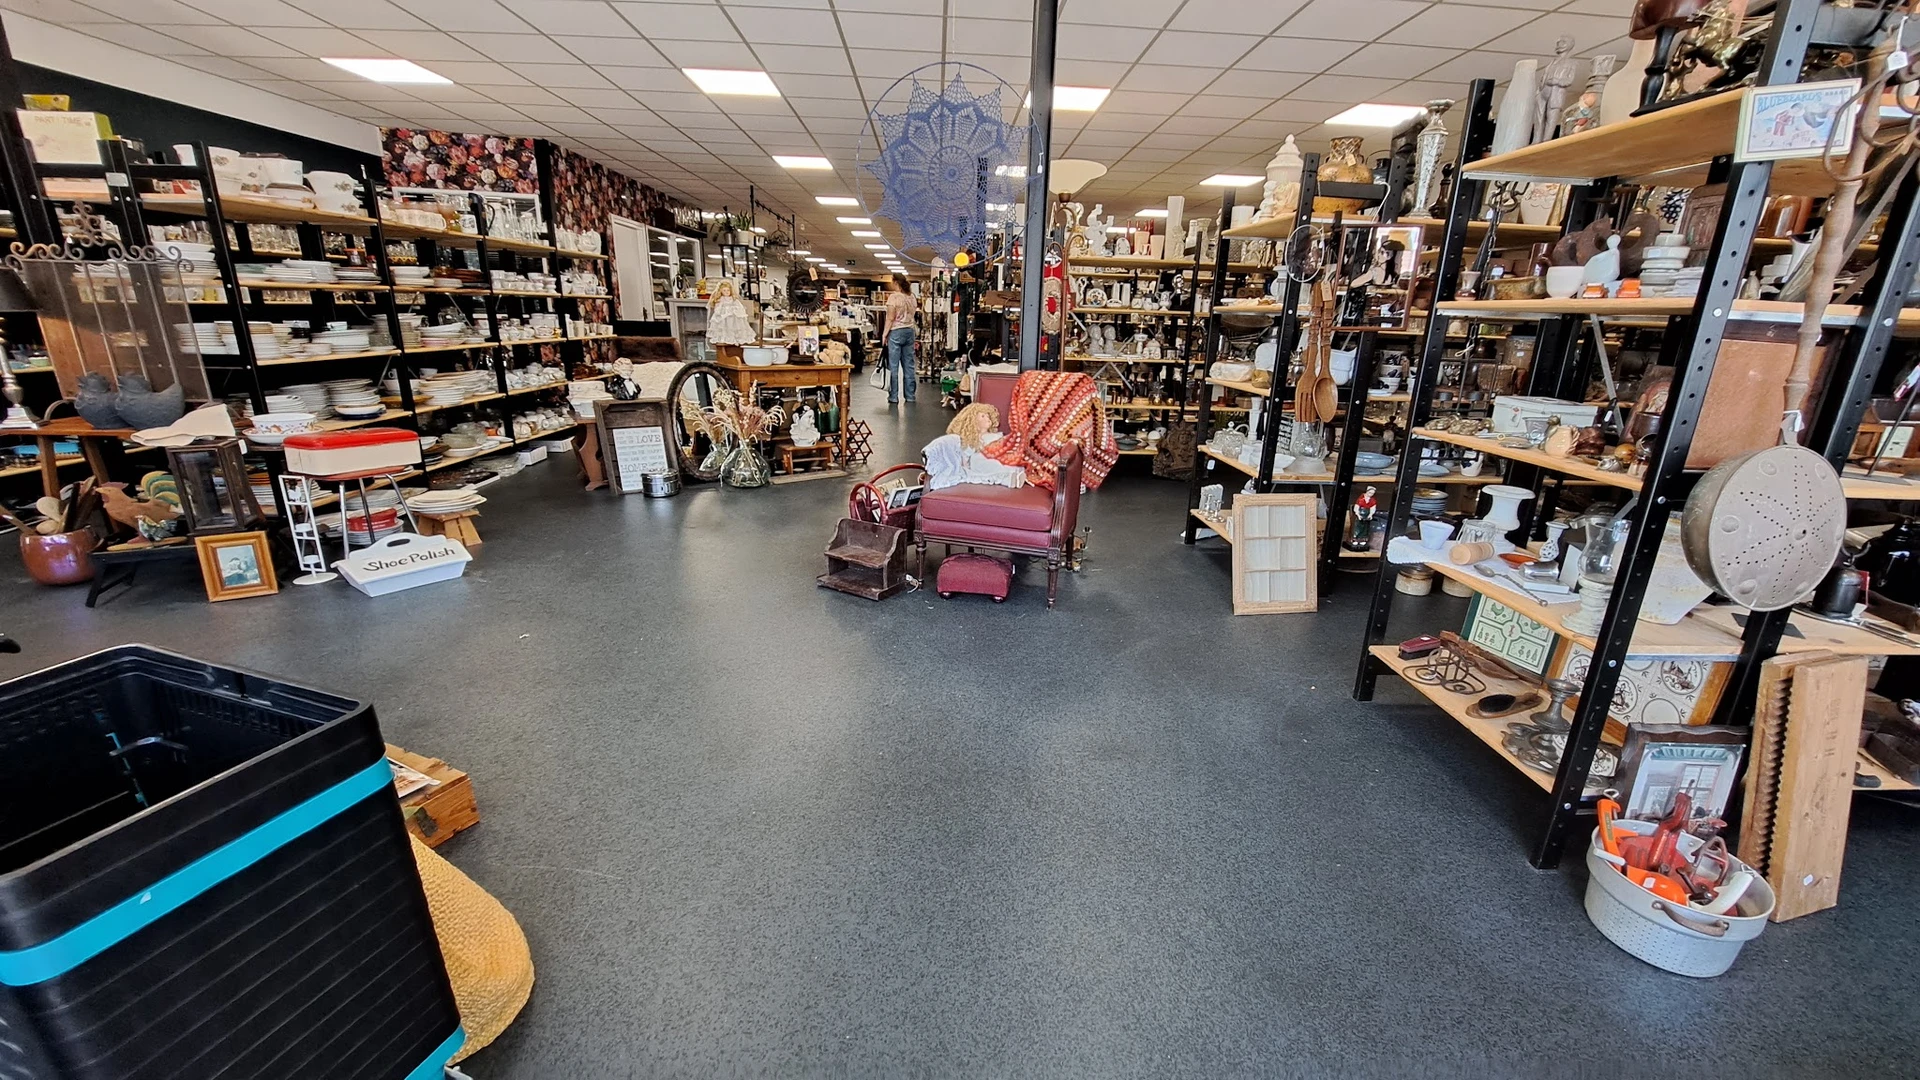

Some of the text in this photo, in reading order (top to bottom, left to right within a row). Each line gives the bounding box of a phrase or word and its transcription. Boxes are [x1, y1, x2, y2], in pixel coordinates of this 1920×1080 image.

[635, 434, 661, 444] LOVE
[363, 548, 455, 572] Shoe Polish
